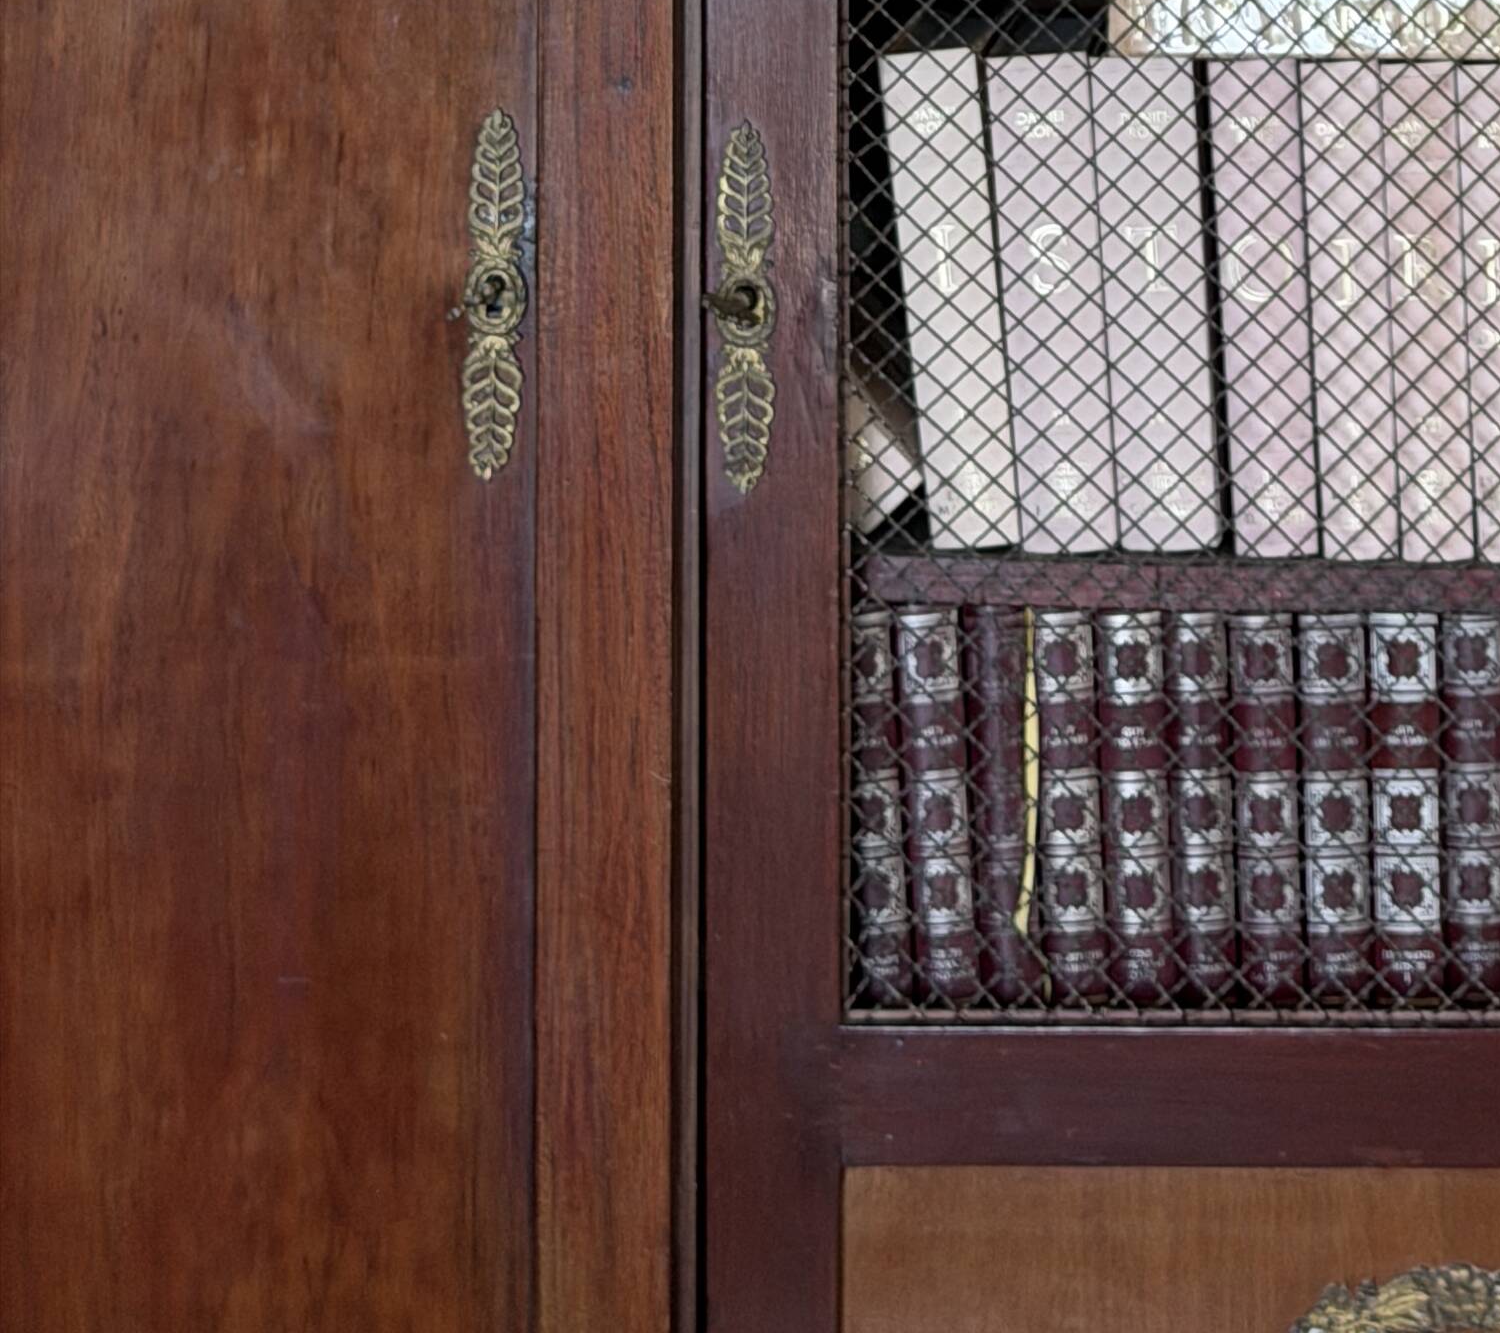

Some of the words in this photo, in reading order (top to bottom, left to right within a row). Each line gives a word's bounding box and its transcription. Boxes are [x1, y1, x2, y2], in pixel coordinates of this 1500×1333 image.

[1028, 223, 1071, 294] S
[1124, 225, 1178, 292] T
[1217, 231, 1295, 303] O
